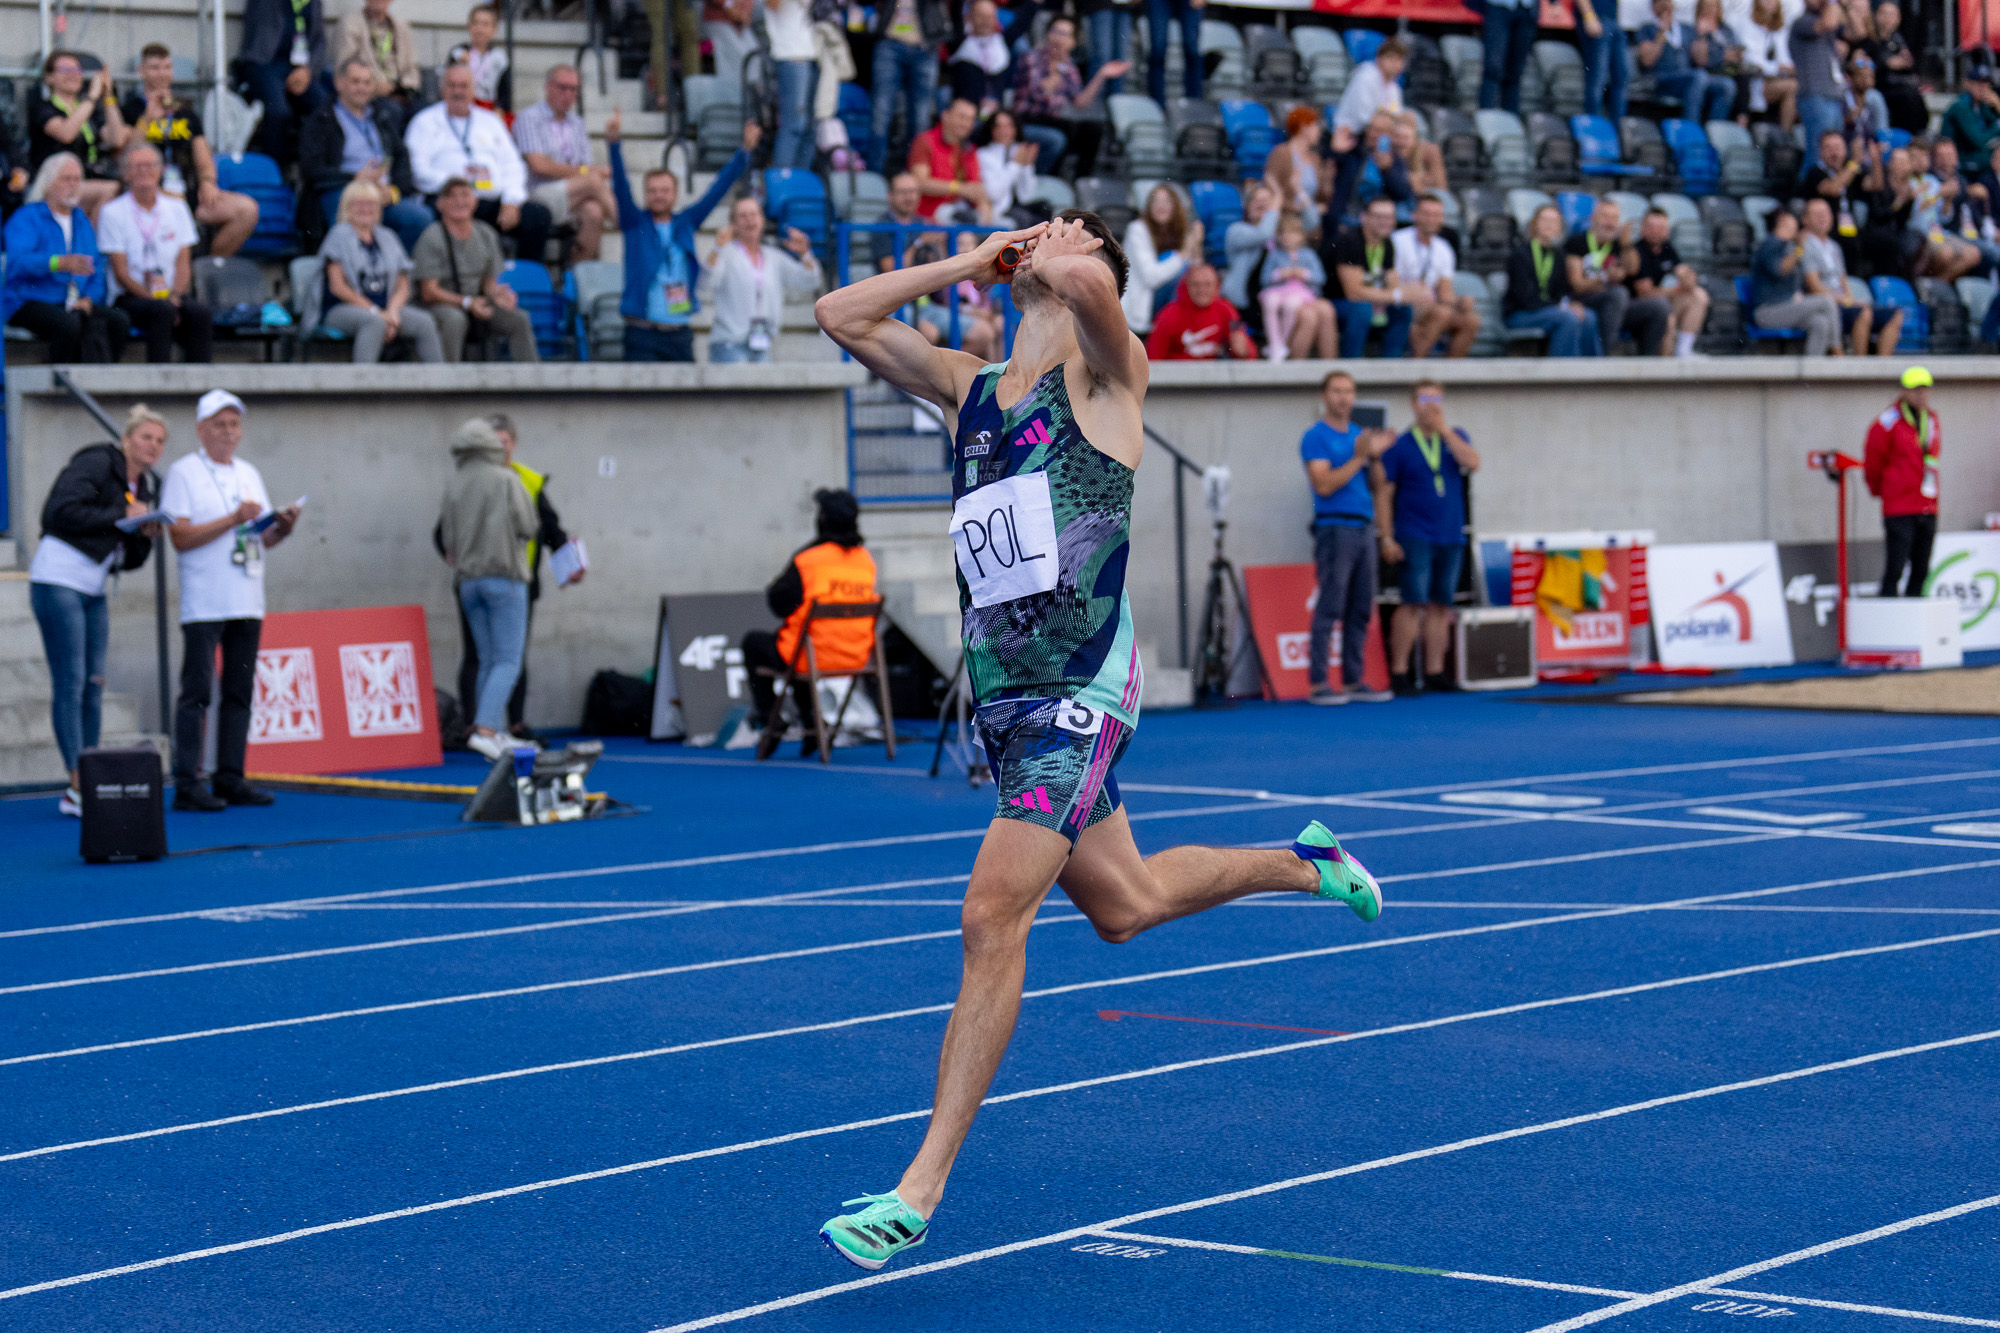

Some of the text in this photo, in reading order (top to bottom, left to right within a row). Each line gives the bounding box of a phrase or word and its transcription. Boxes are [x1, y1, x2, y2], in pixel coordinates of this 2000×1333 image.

[966, 446, 988, 456] ORLEN
[962, 504, 1046, 578] POL
[252, 709, 317, 737] PZLA
[352, 702, 416, 731] PZLA
